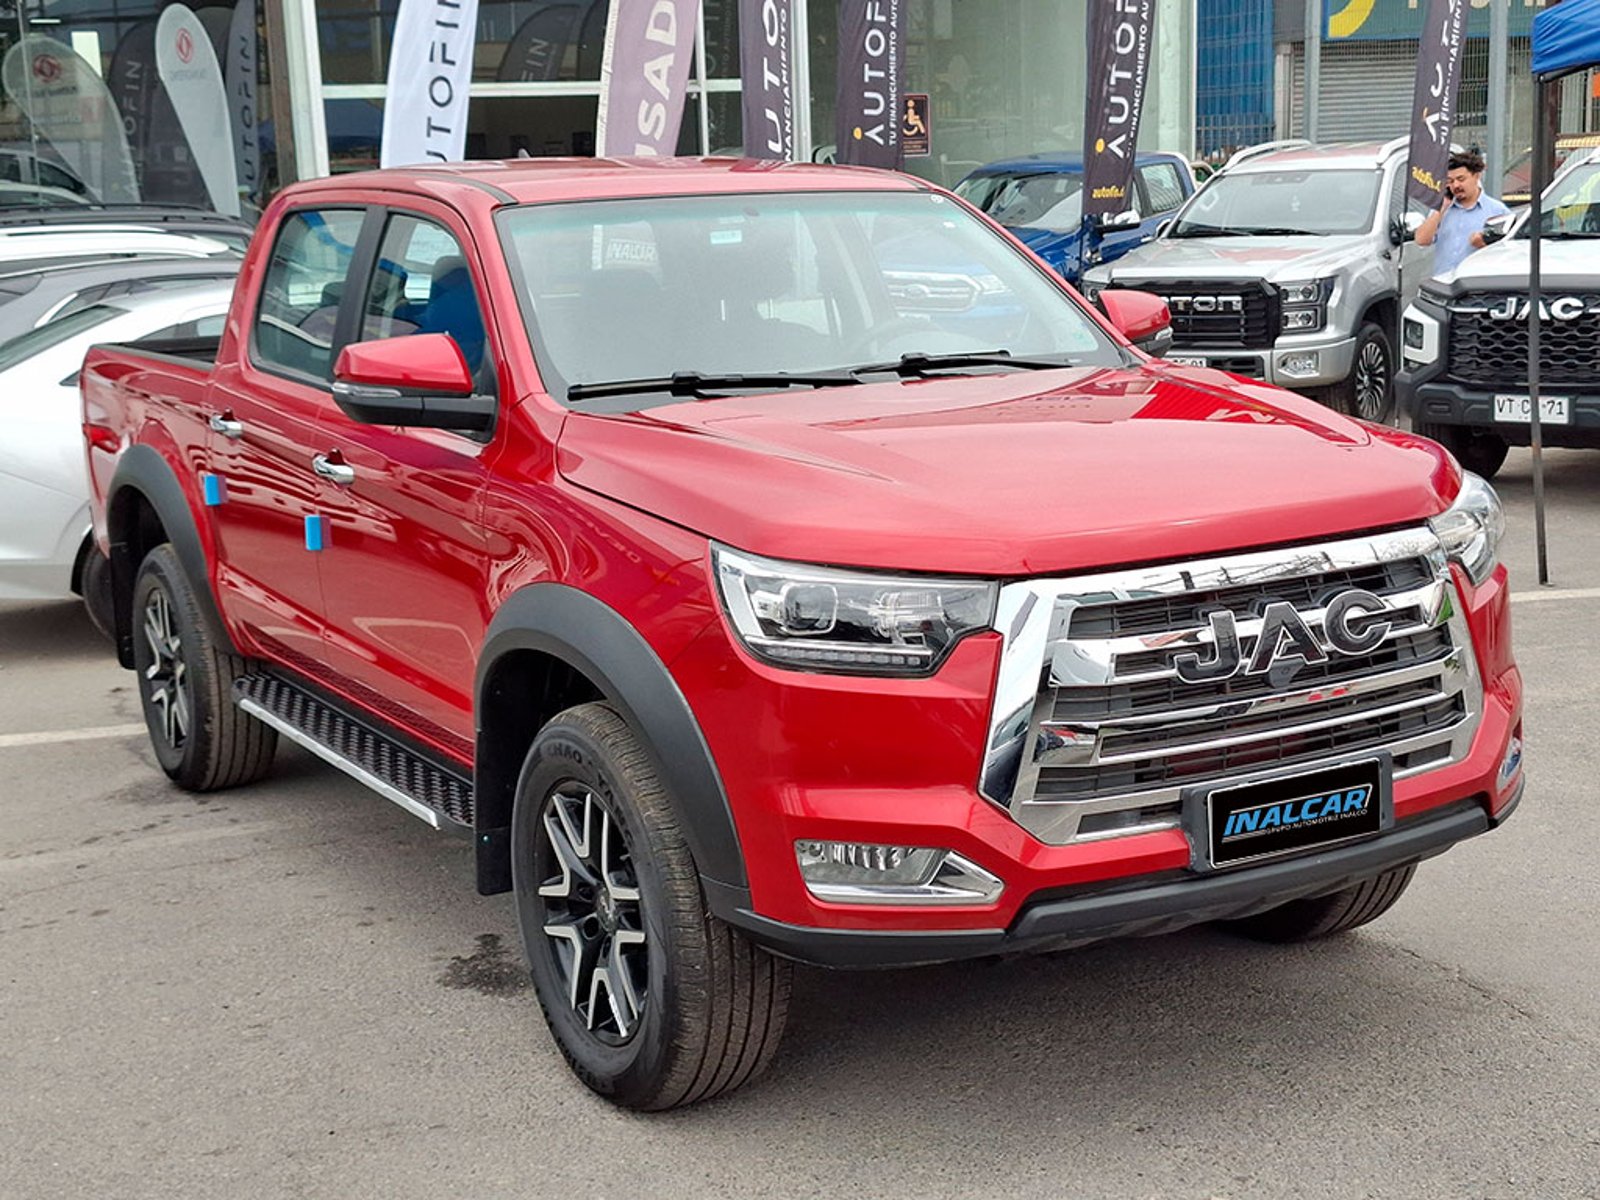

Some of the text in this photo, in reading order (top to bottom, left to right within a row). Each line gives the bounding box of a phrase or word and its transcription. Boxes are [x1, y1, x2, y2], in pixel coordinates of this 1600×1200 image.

[889, 130, 897, 146] TU
[1489, 297, 1585, 320] JAC
[1174, 589, 1394, 685] JAC
[1223, 789, 1366, 837] INALCAR
